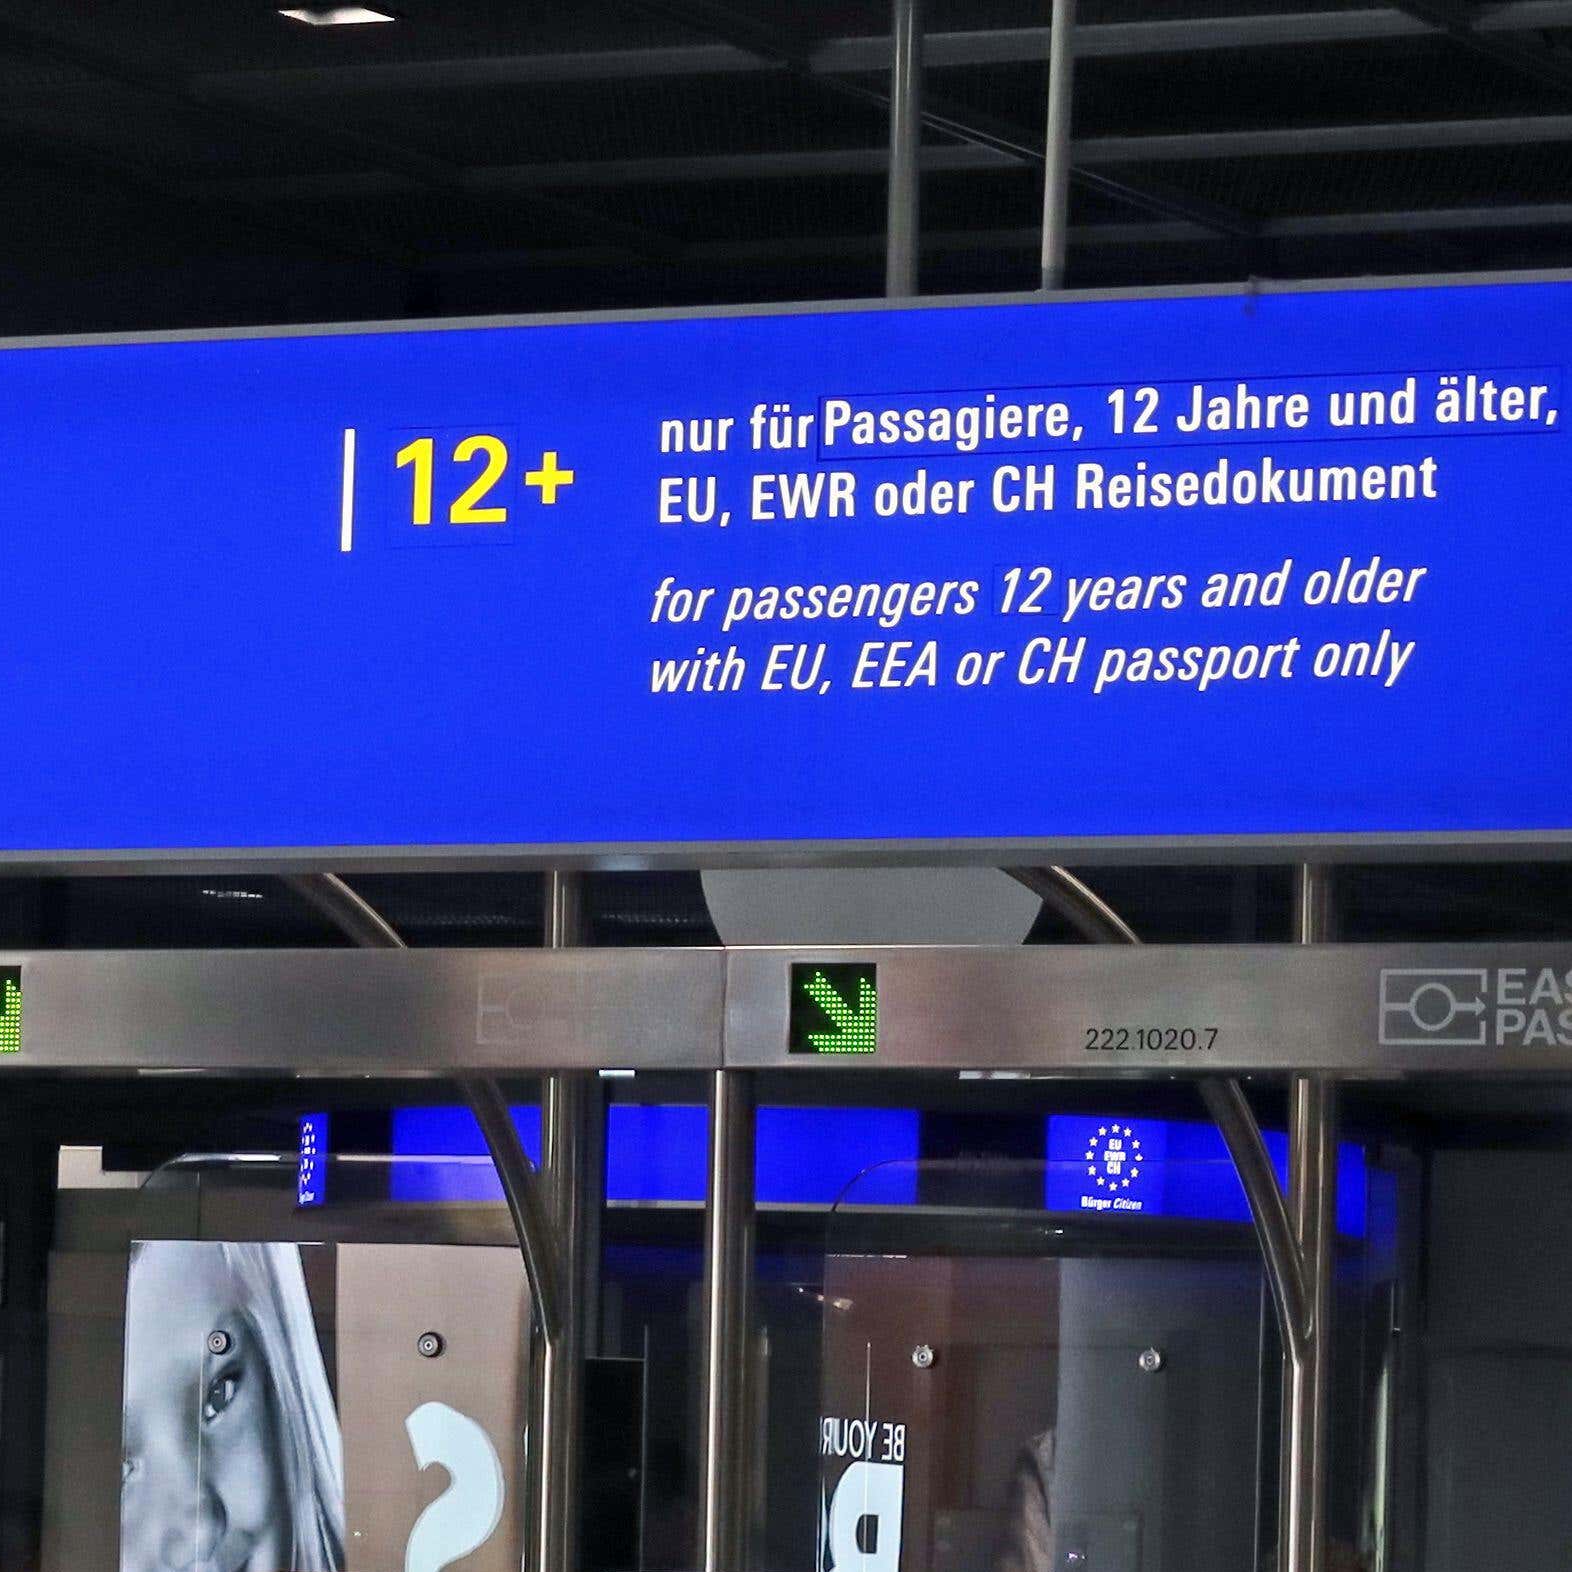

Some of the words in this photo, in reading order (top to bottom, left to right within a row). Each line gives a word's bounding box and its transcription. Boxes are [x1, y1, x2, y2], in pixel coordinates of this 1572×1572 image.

[660, 418, 735, 453] nur
[749, 403, 815, 450] für
[825, 394, 1083, 458] Passagiere,
[1107, 387, 1159, 434] 12
[1176, 378, 1310, 433] Jahre
[1329, 377, 1416, 427] und
[1435, 374, 1558, 426] älter,
[396, 435, 574, 525] 12+
[660, 474, 731, 528] EU,
[751, 471, 856, 521] EWR
[874, 465, 975, 517] oder
[992, 465, 1055, 513] CH
[1076, 456, 1438, 511] Reisedokument
[650, 576, 716, 623] for
[721, 580, 980, 632] passengers
[1000, 566, 1053, 614] 12
[1061, 573, 1187, 623] years
[1201, 558, 1293, 608] and
[1303, 555, 1428, 607] older
[651, 644, 746, 693] with
[760, 642, 831, 695] EU,
[851, 640, 937, 689] EEA
[955, 651, 1006, 687] or
[1018, 636, 1087, 685] CH
[1093, 636, 1301, 694] passport
[1313, 628, 1416, 688] only
[1497, 967, 1572, 1006] EA
[1085, 1027, 1219, 1052] 222.1020.7
